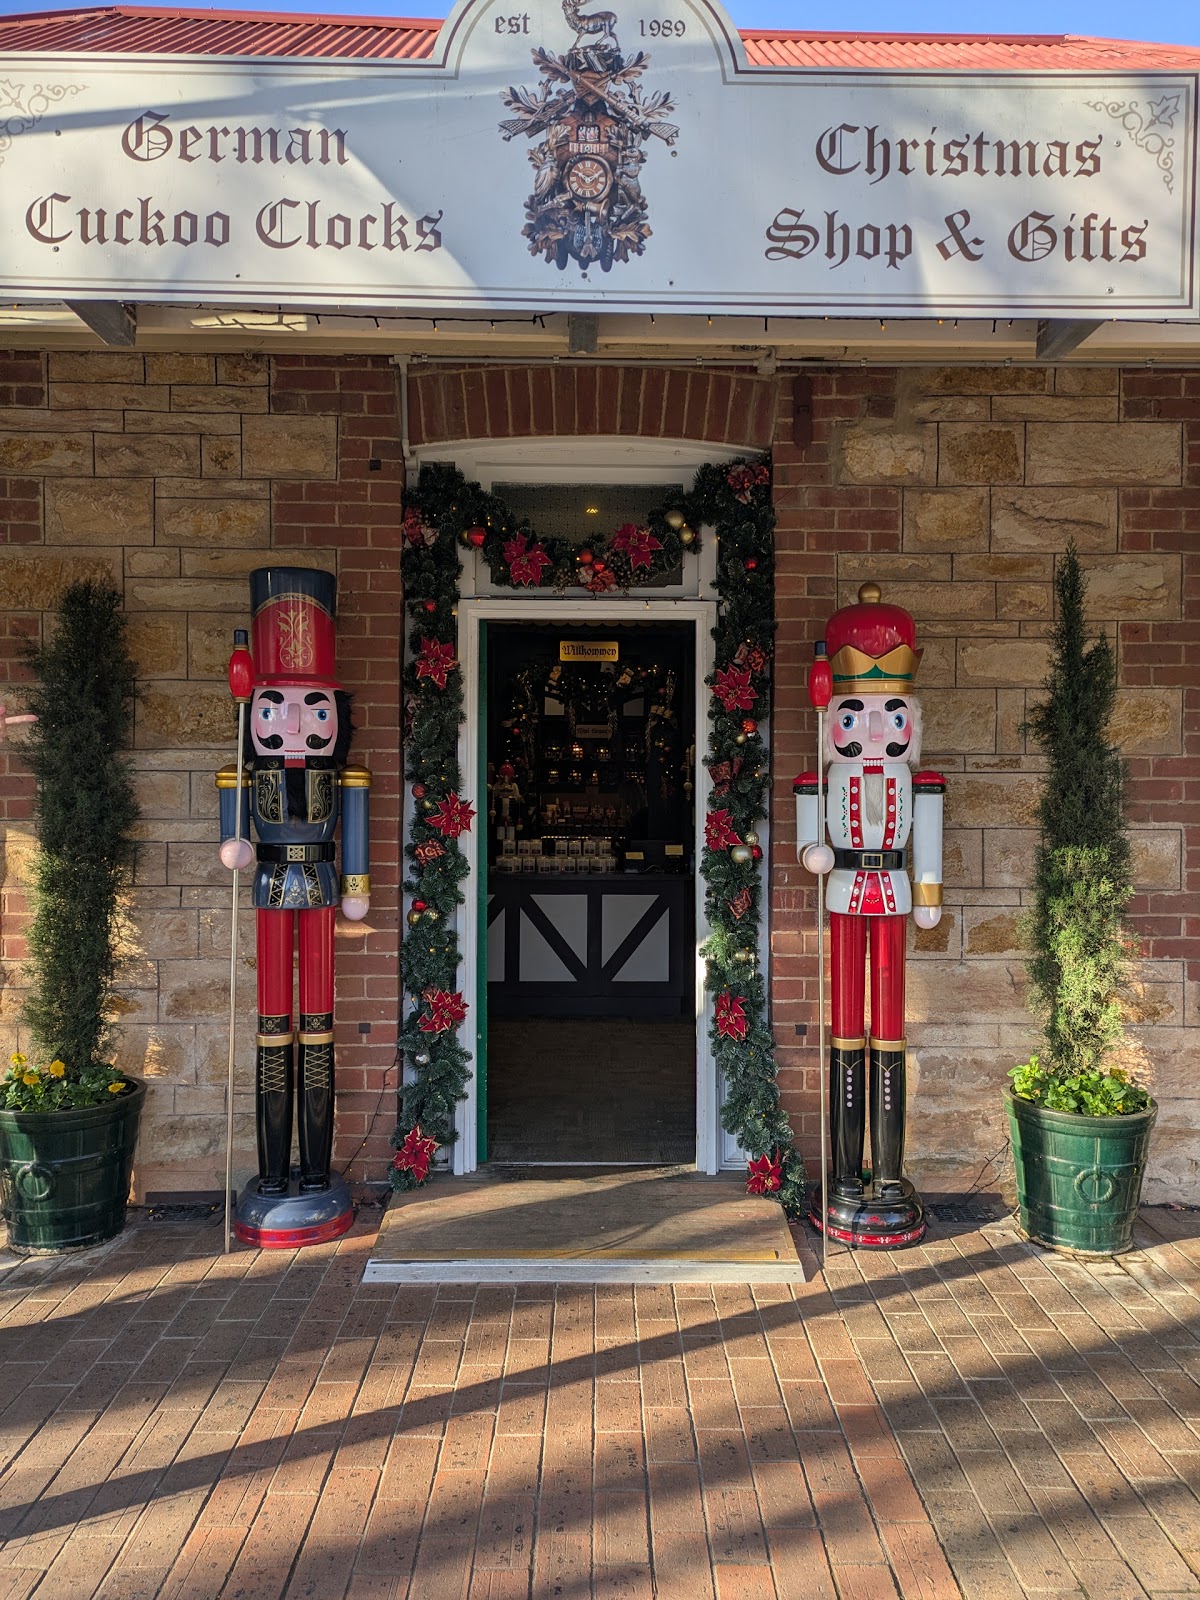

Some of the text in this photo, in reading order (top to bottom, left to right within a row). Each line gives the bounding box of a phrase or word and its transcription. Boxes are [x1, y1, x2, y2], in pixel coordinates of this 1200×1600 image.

[495, 13, 530, 35] est
[638, 19, 686, 38] 1989
[121, 110, 349, 165] German
[816, 123, 1103, 186] Christmas
[26, 193, 443, 252] Cuckoo Clocks
[765, 208, 1148, 270] Shop & Gifts
[561, 644, 617, 658] Willkommen
